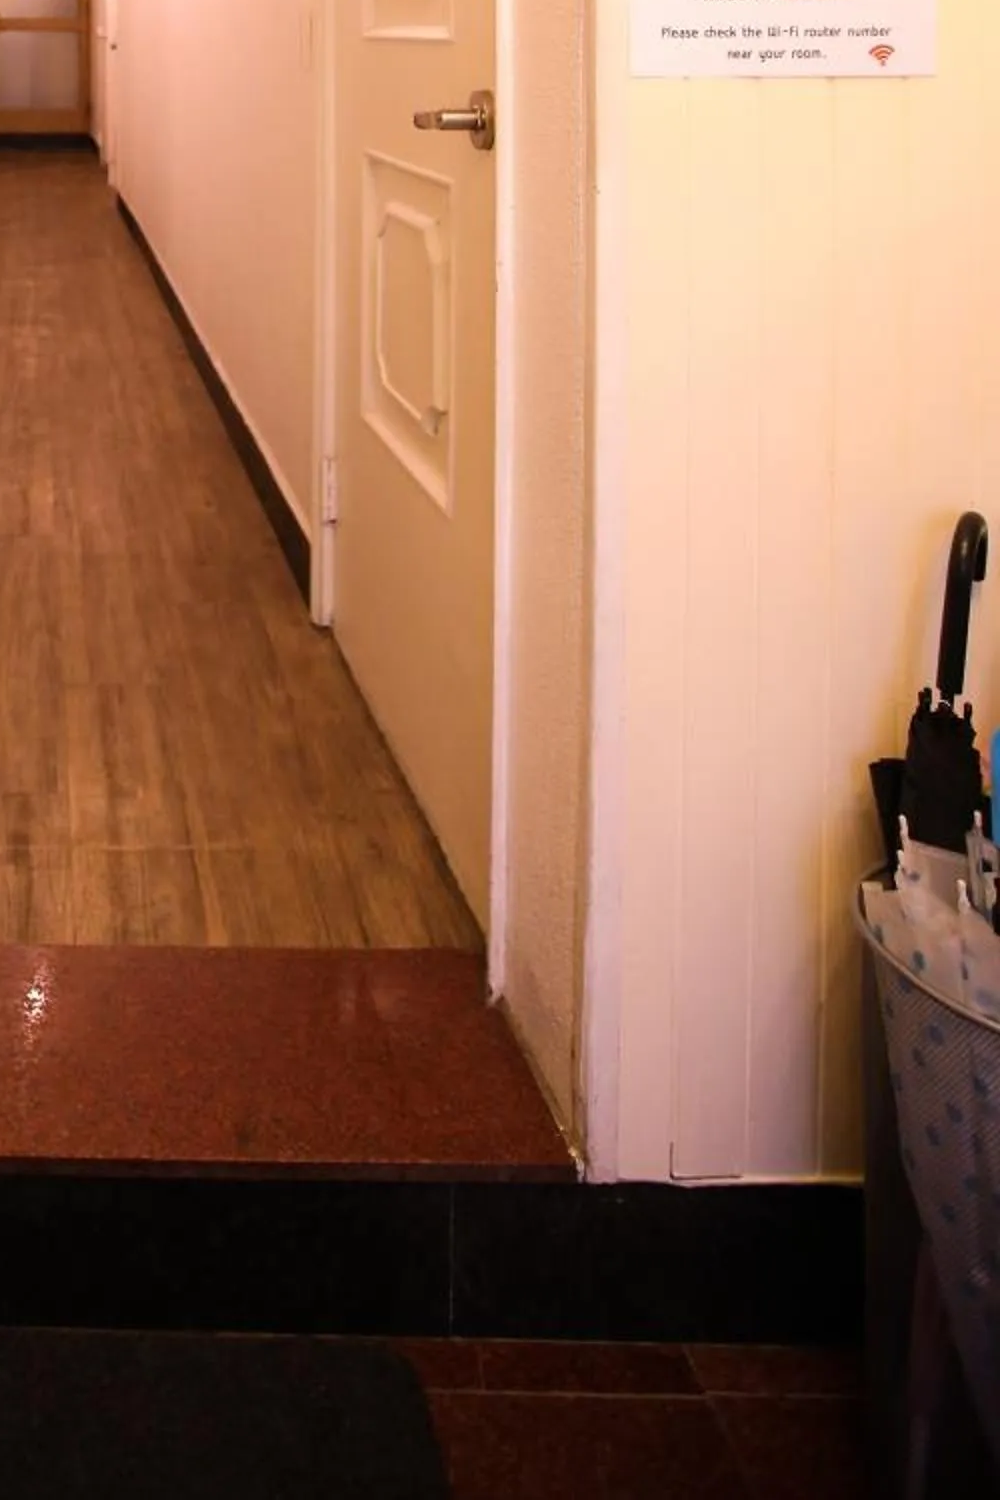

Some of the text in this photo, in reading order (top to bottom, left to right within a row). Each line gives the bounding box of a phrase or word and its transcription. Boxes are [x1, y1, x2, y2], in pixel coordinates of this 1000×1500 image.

[661, 25, 891, 38] Please check the Wi-Fi router number
[728, 48, 827, 62] near your room.
